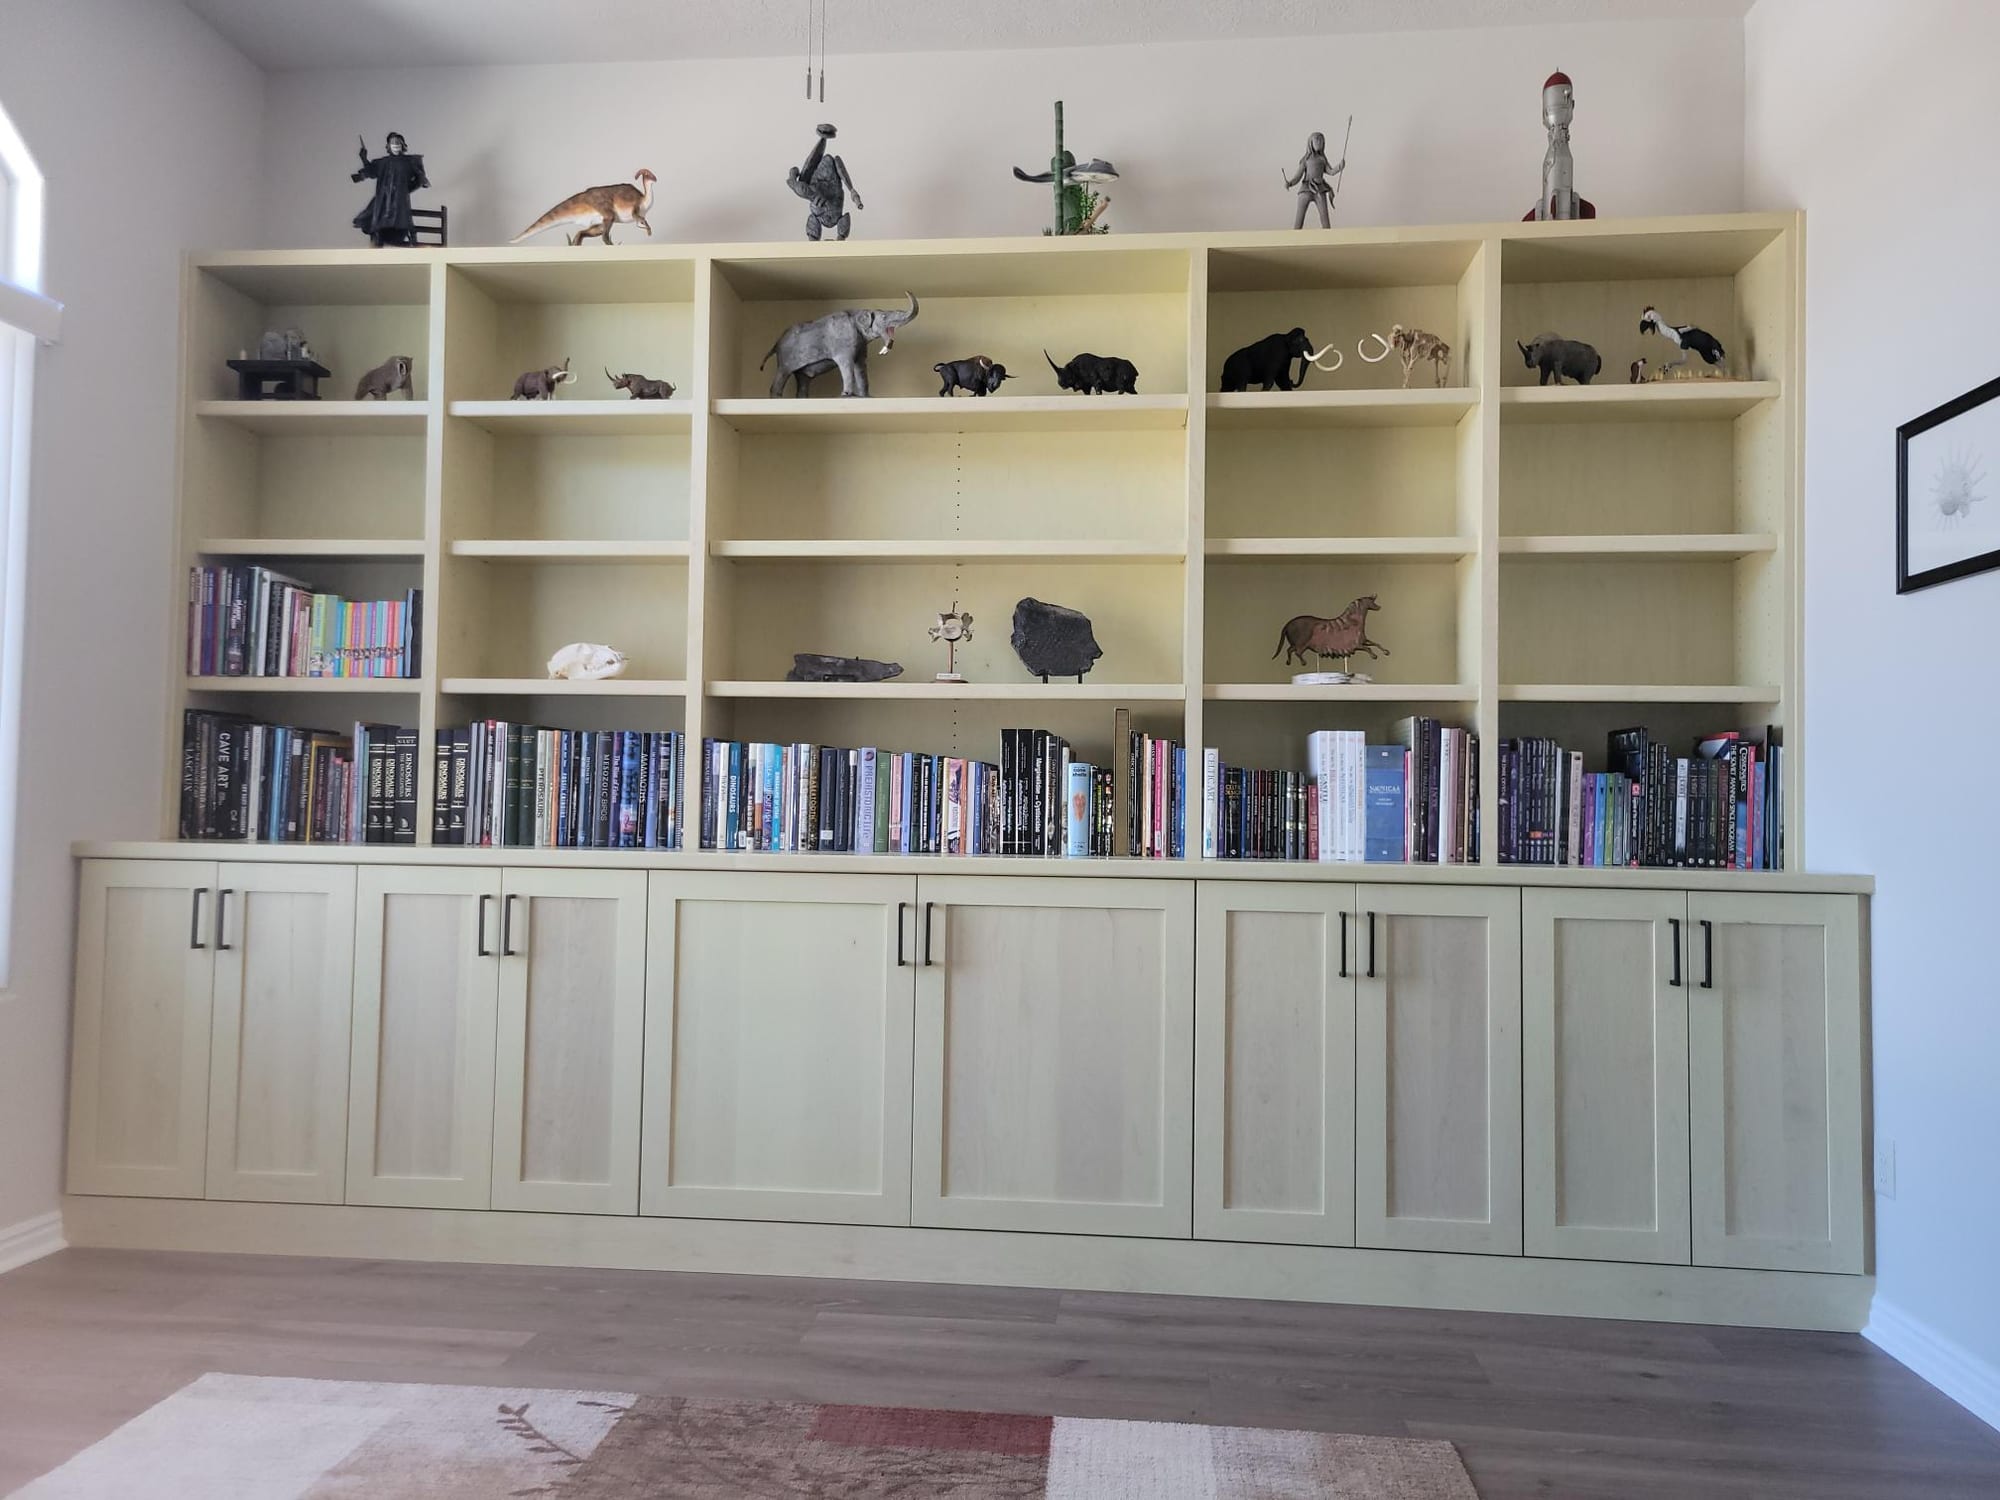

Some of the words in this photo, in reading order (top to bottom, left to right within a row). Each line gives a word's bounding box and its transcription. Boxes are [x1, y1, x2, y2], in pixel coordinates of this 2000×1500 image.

[218, 732, 231, 762] CAVE
[184, 749, 194, 792] LASCAUX
[217, 766, 229, 789] ART
[375, 758, 383, 797] DINOSAURS
[601, 754, 610, 797] MESOZOIC
[639, 753, 648, 803] MAMMOTHS
[1207, 753, 1215, 784] CELTIC
[600, 799, 608, 821] BIRDS
[864, 765, 873, 820] PREHISTORIC
[1207, 785, 1215, 802] ART
